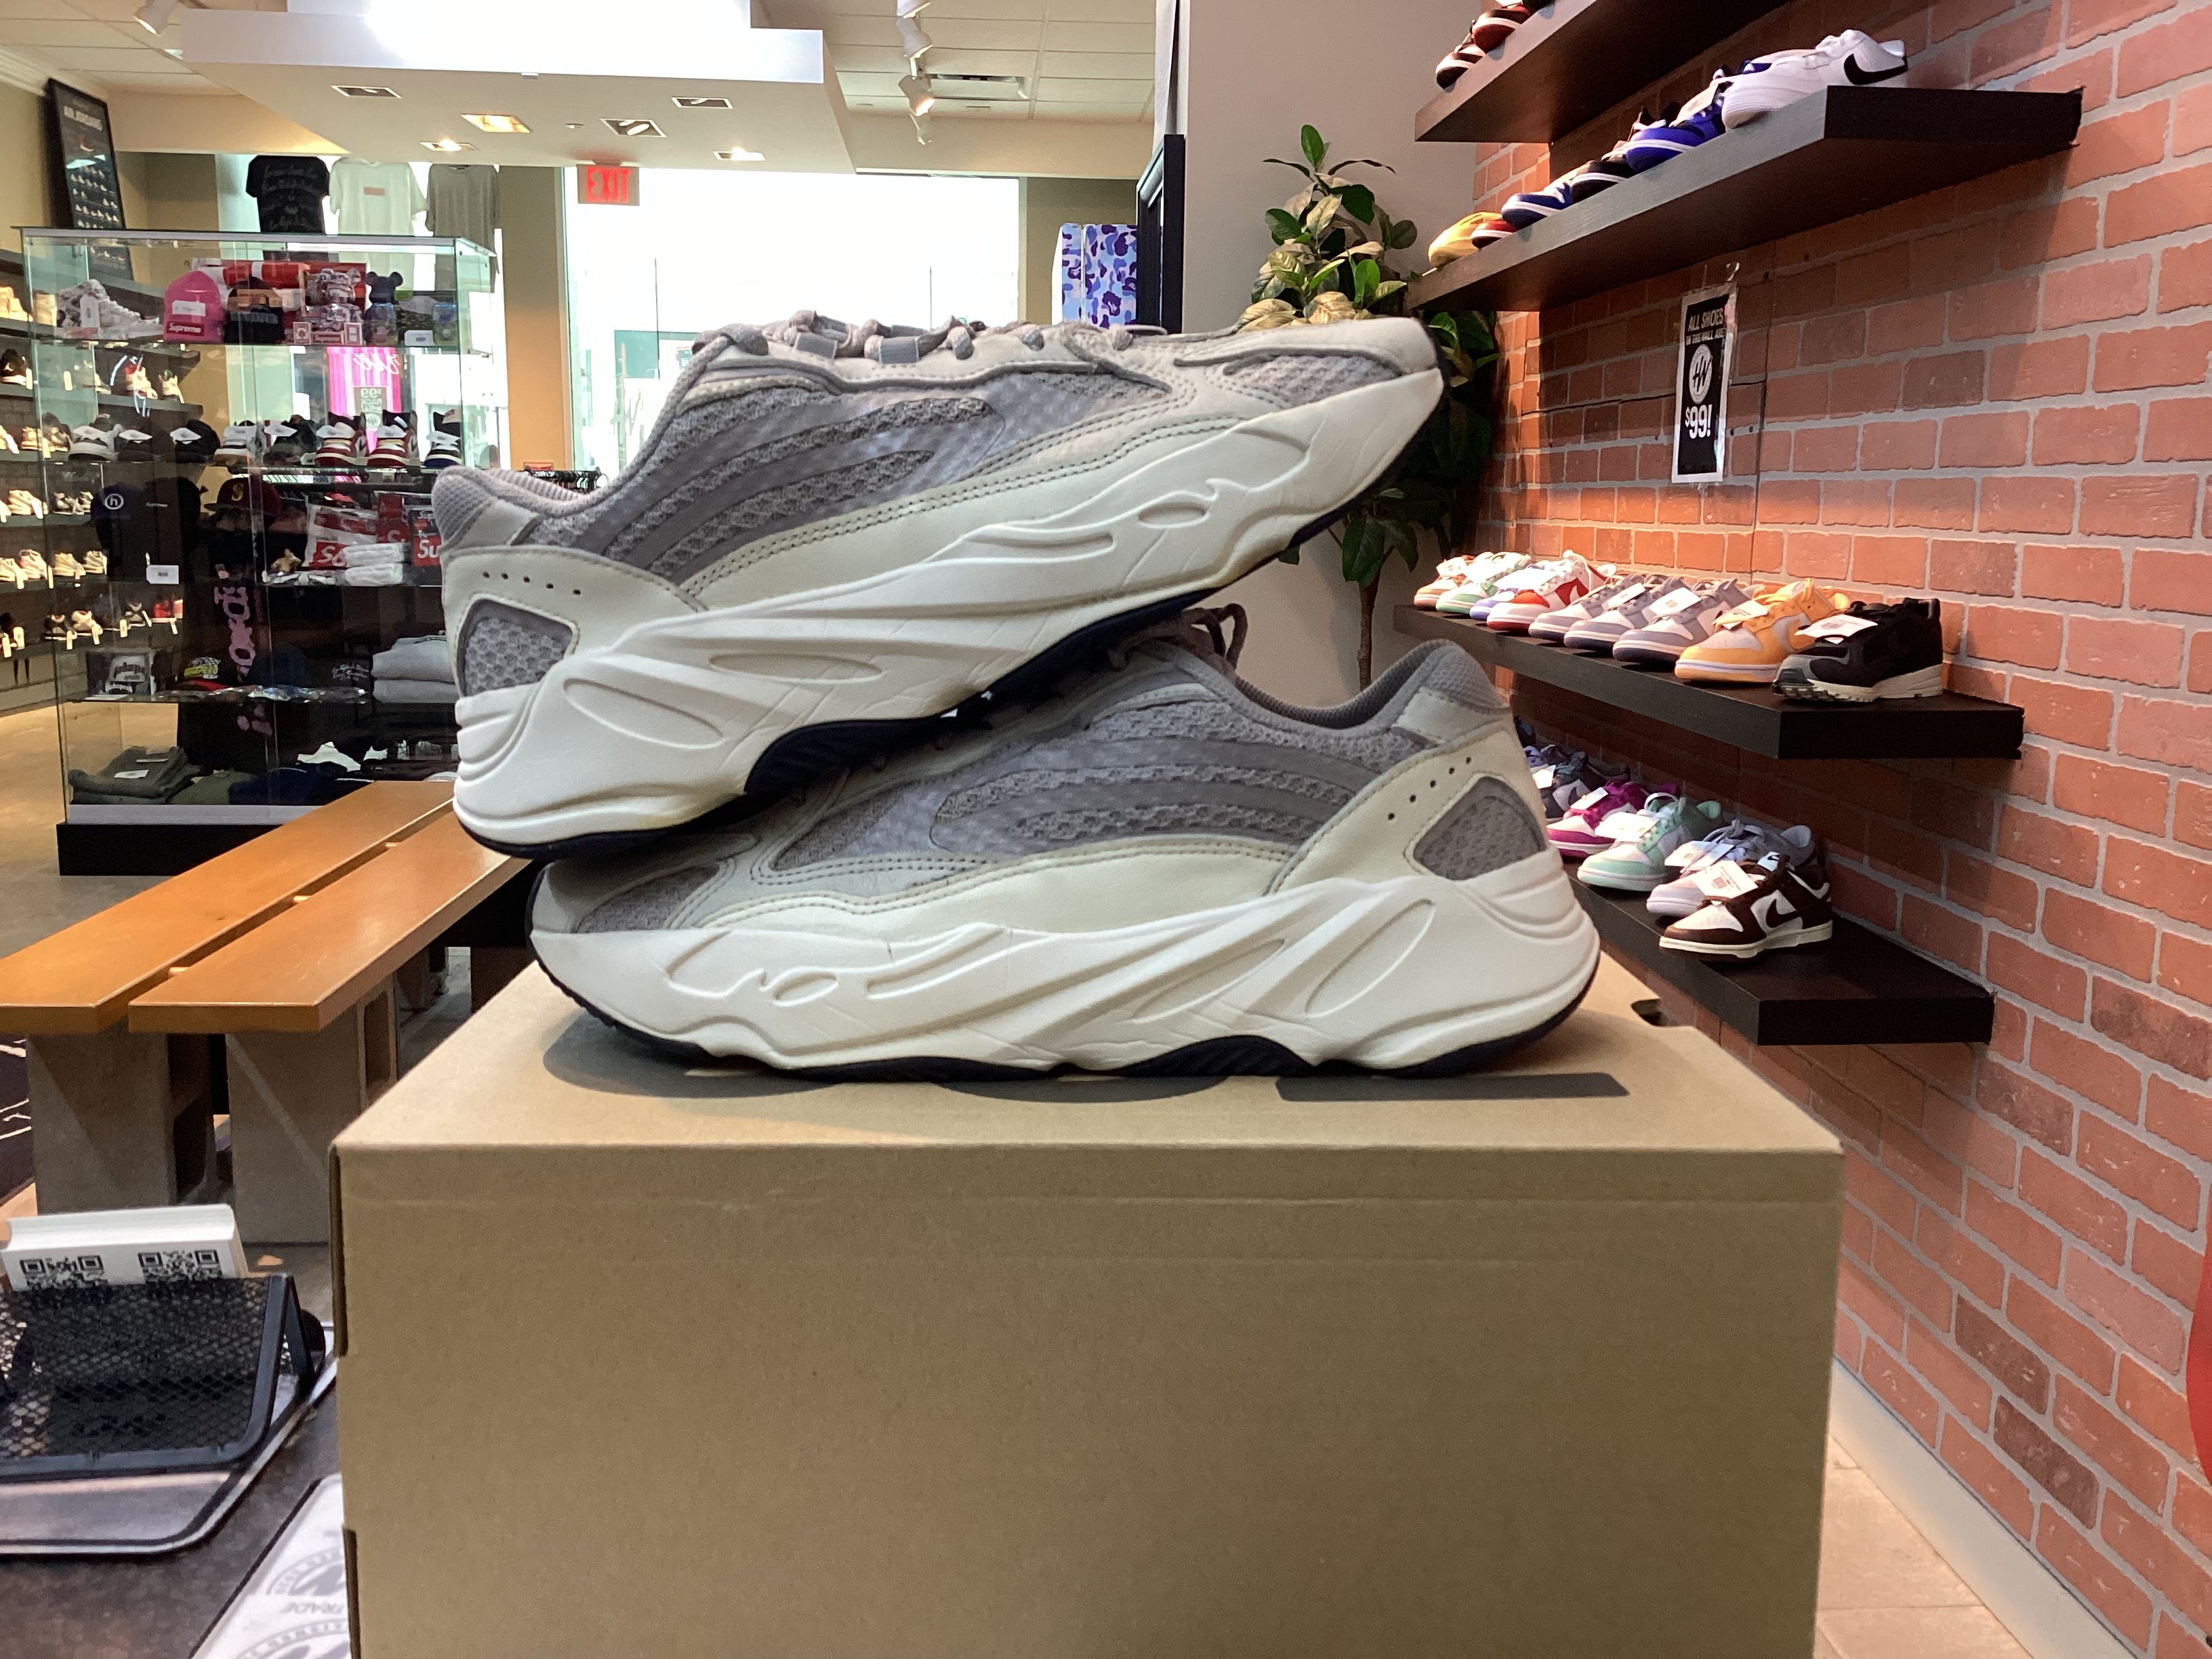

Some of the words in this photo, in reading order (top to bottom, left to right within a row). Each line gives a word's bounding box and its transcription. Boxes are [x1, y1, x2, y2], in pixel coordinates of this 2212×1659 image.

[586, 166, 631, 203] EXIT
[169, 323, 202, 333] Supreme
[1687, 314, 1700, 332] ALL
[1701, 308, 1724, 329] SHOES
[1701, 330, 1714, 342] WALL
[1685, 404, 1713, 439] $99!
